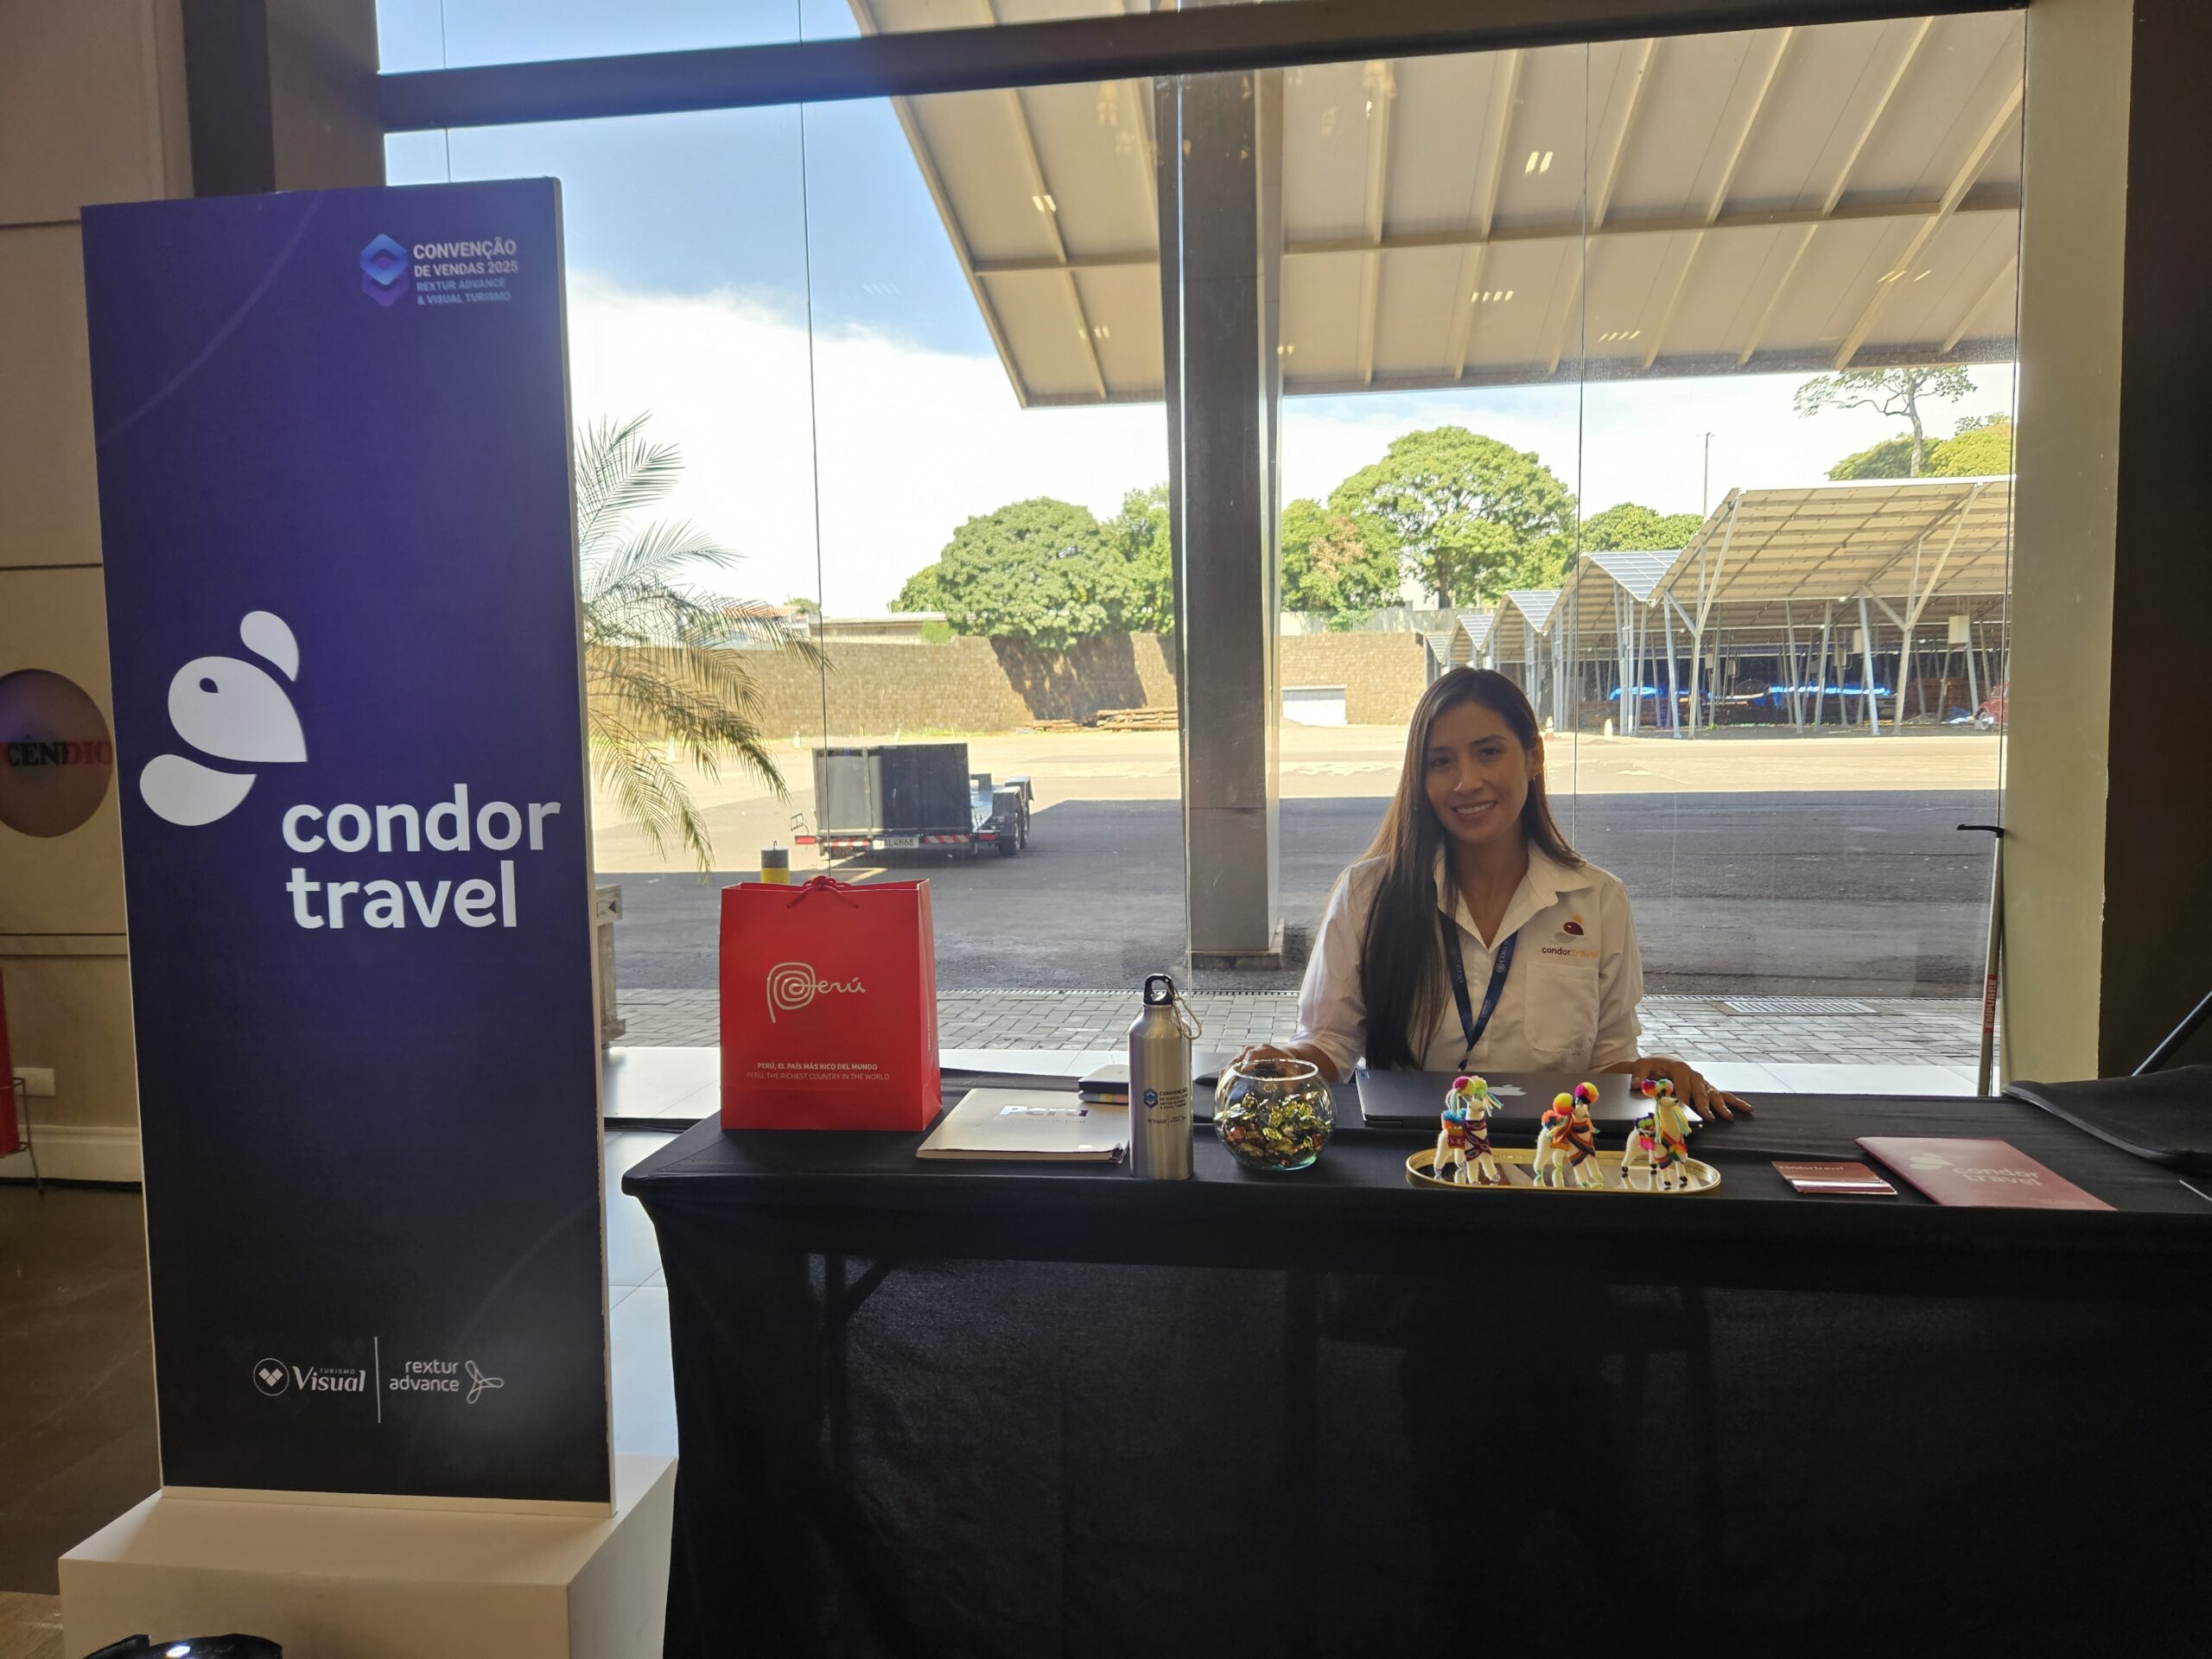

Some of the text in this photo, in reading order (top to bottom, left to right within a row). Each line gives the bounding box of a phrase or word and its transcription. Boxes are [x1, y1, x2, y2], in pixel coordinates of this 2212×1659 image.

[412, 237, 518, 260] CONVENÇÃO
[414, 260, 519, 277] DE VENDAS 2025
[416, 277, 506, 292] REXTUR ADVANCE
[427, 293, 463, 305] VISUAL
[465, 291, 512, 302] TURISMO
[282, 783, 562, 853] condor
[286, 860, 518, 929] travel
[1986, 979, 1997, 1028] EMPURRE
[787, 1062, 802, 1071] PAÍS
[804, 1062, 818, 1071] MÁS
[1953, 1167, 2040, 1179] condor
[1963, 1173, 2042, 1185] travel
[405, 1359, 460, 1375] rextur
[291, 1365, 366, 1392] Visual
[390, 1375, 460, 1393] advance
